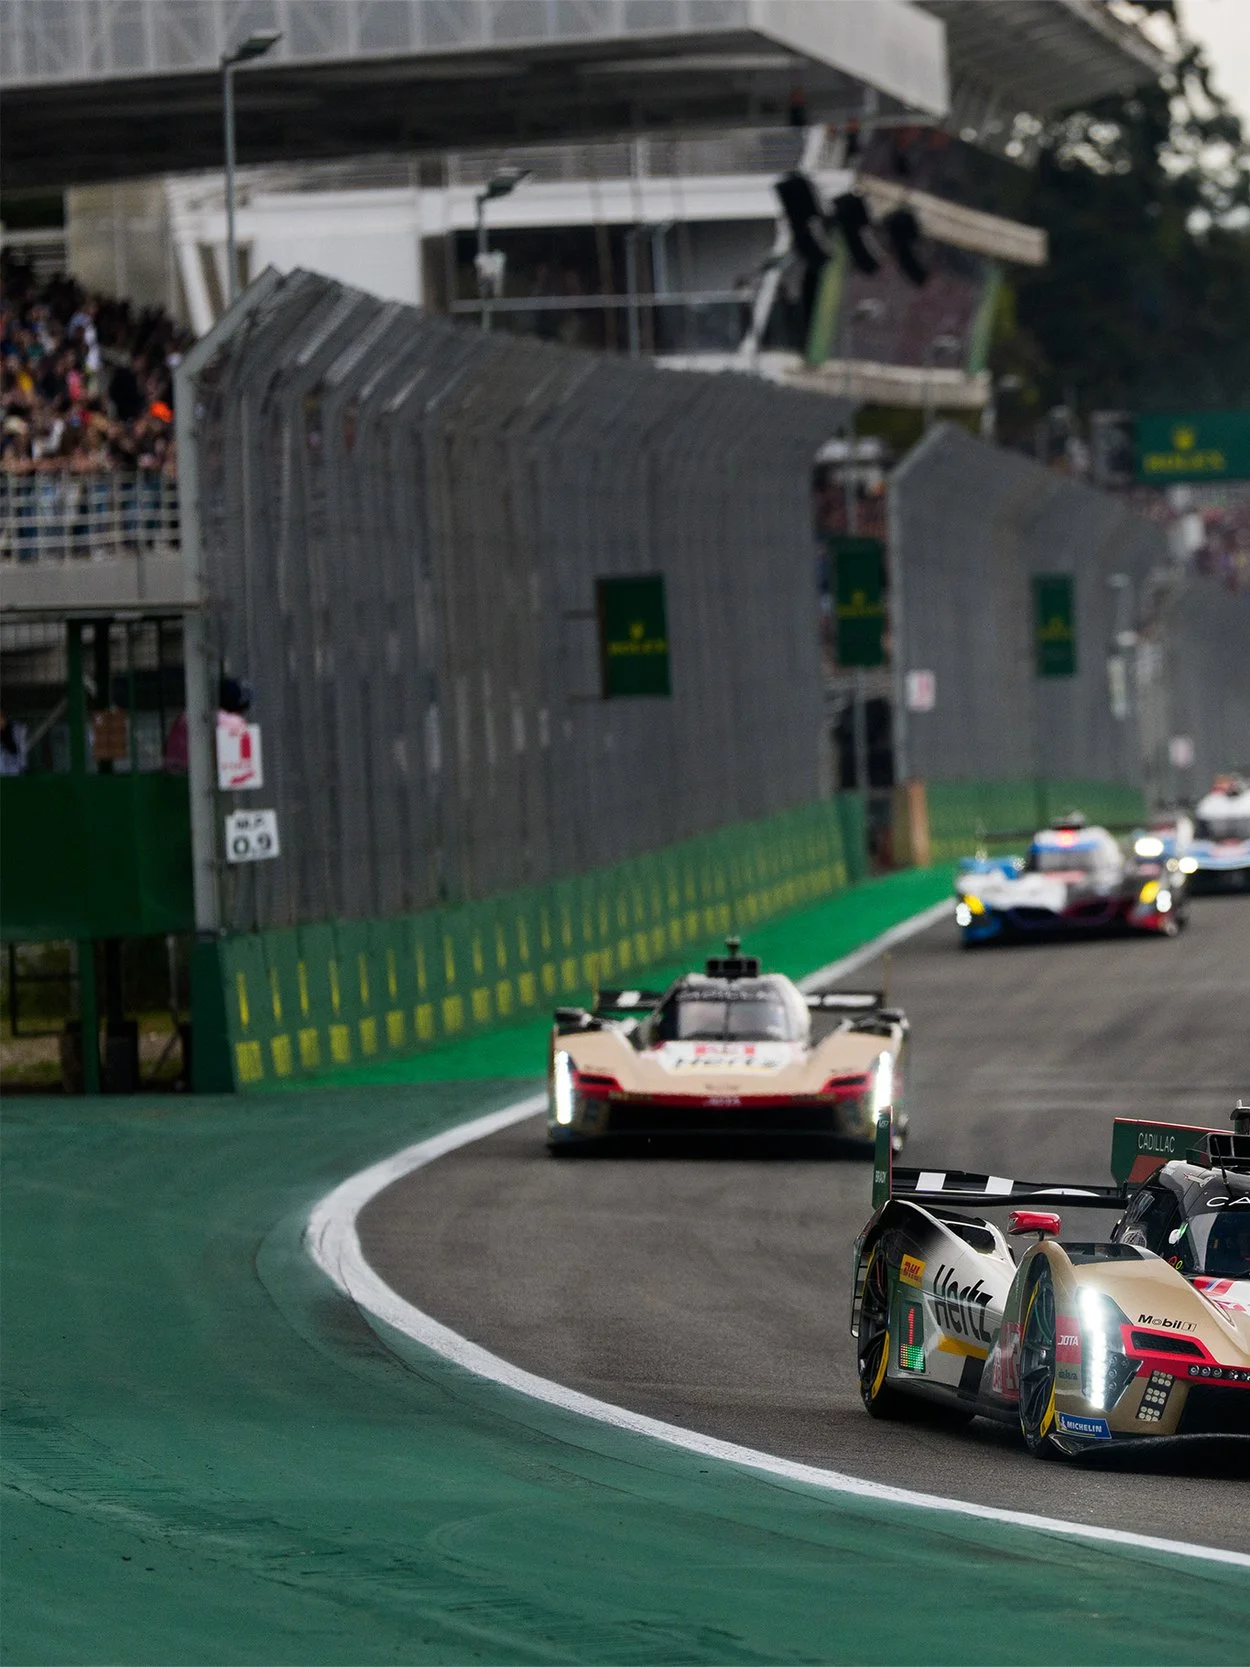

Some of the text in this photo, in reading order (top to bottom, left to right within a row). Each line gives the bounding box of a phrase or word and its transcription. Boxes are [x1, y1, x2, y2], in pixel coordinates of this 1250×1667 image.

[1137, 1132, 1175, 1153] CADILLAC
[932, 1264, 993, 1342] Hertz
[1138, 1314, 1182, 1329] Mobil
[1058, 1334, 1079, 1346] JOTA
[1066, 1420, 1103, 1433] MICHELIN
